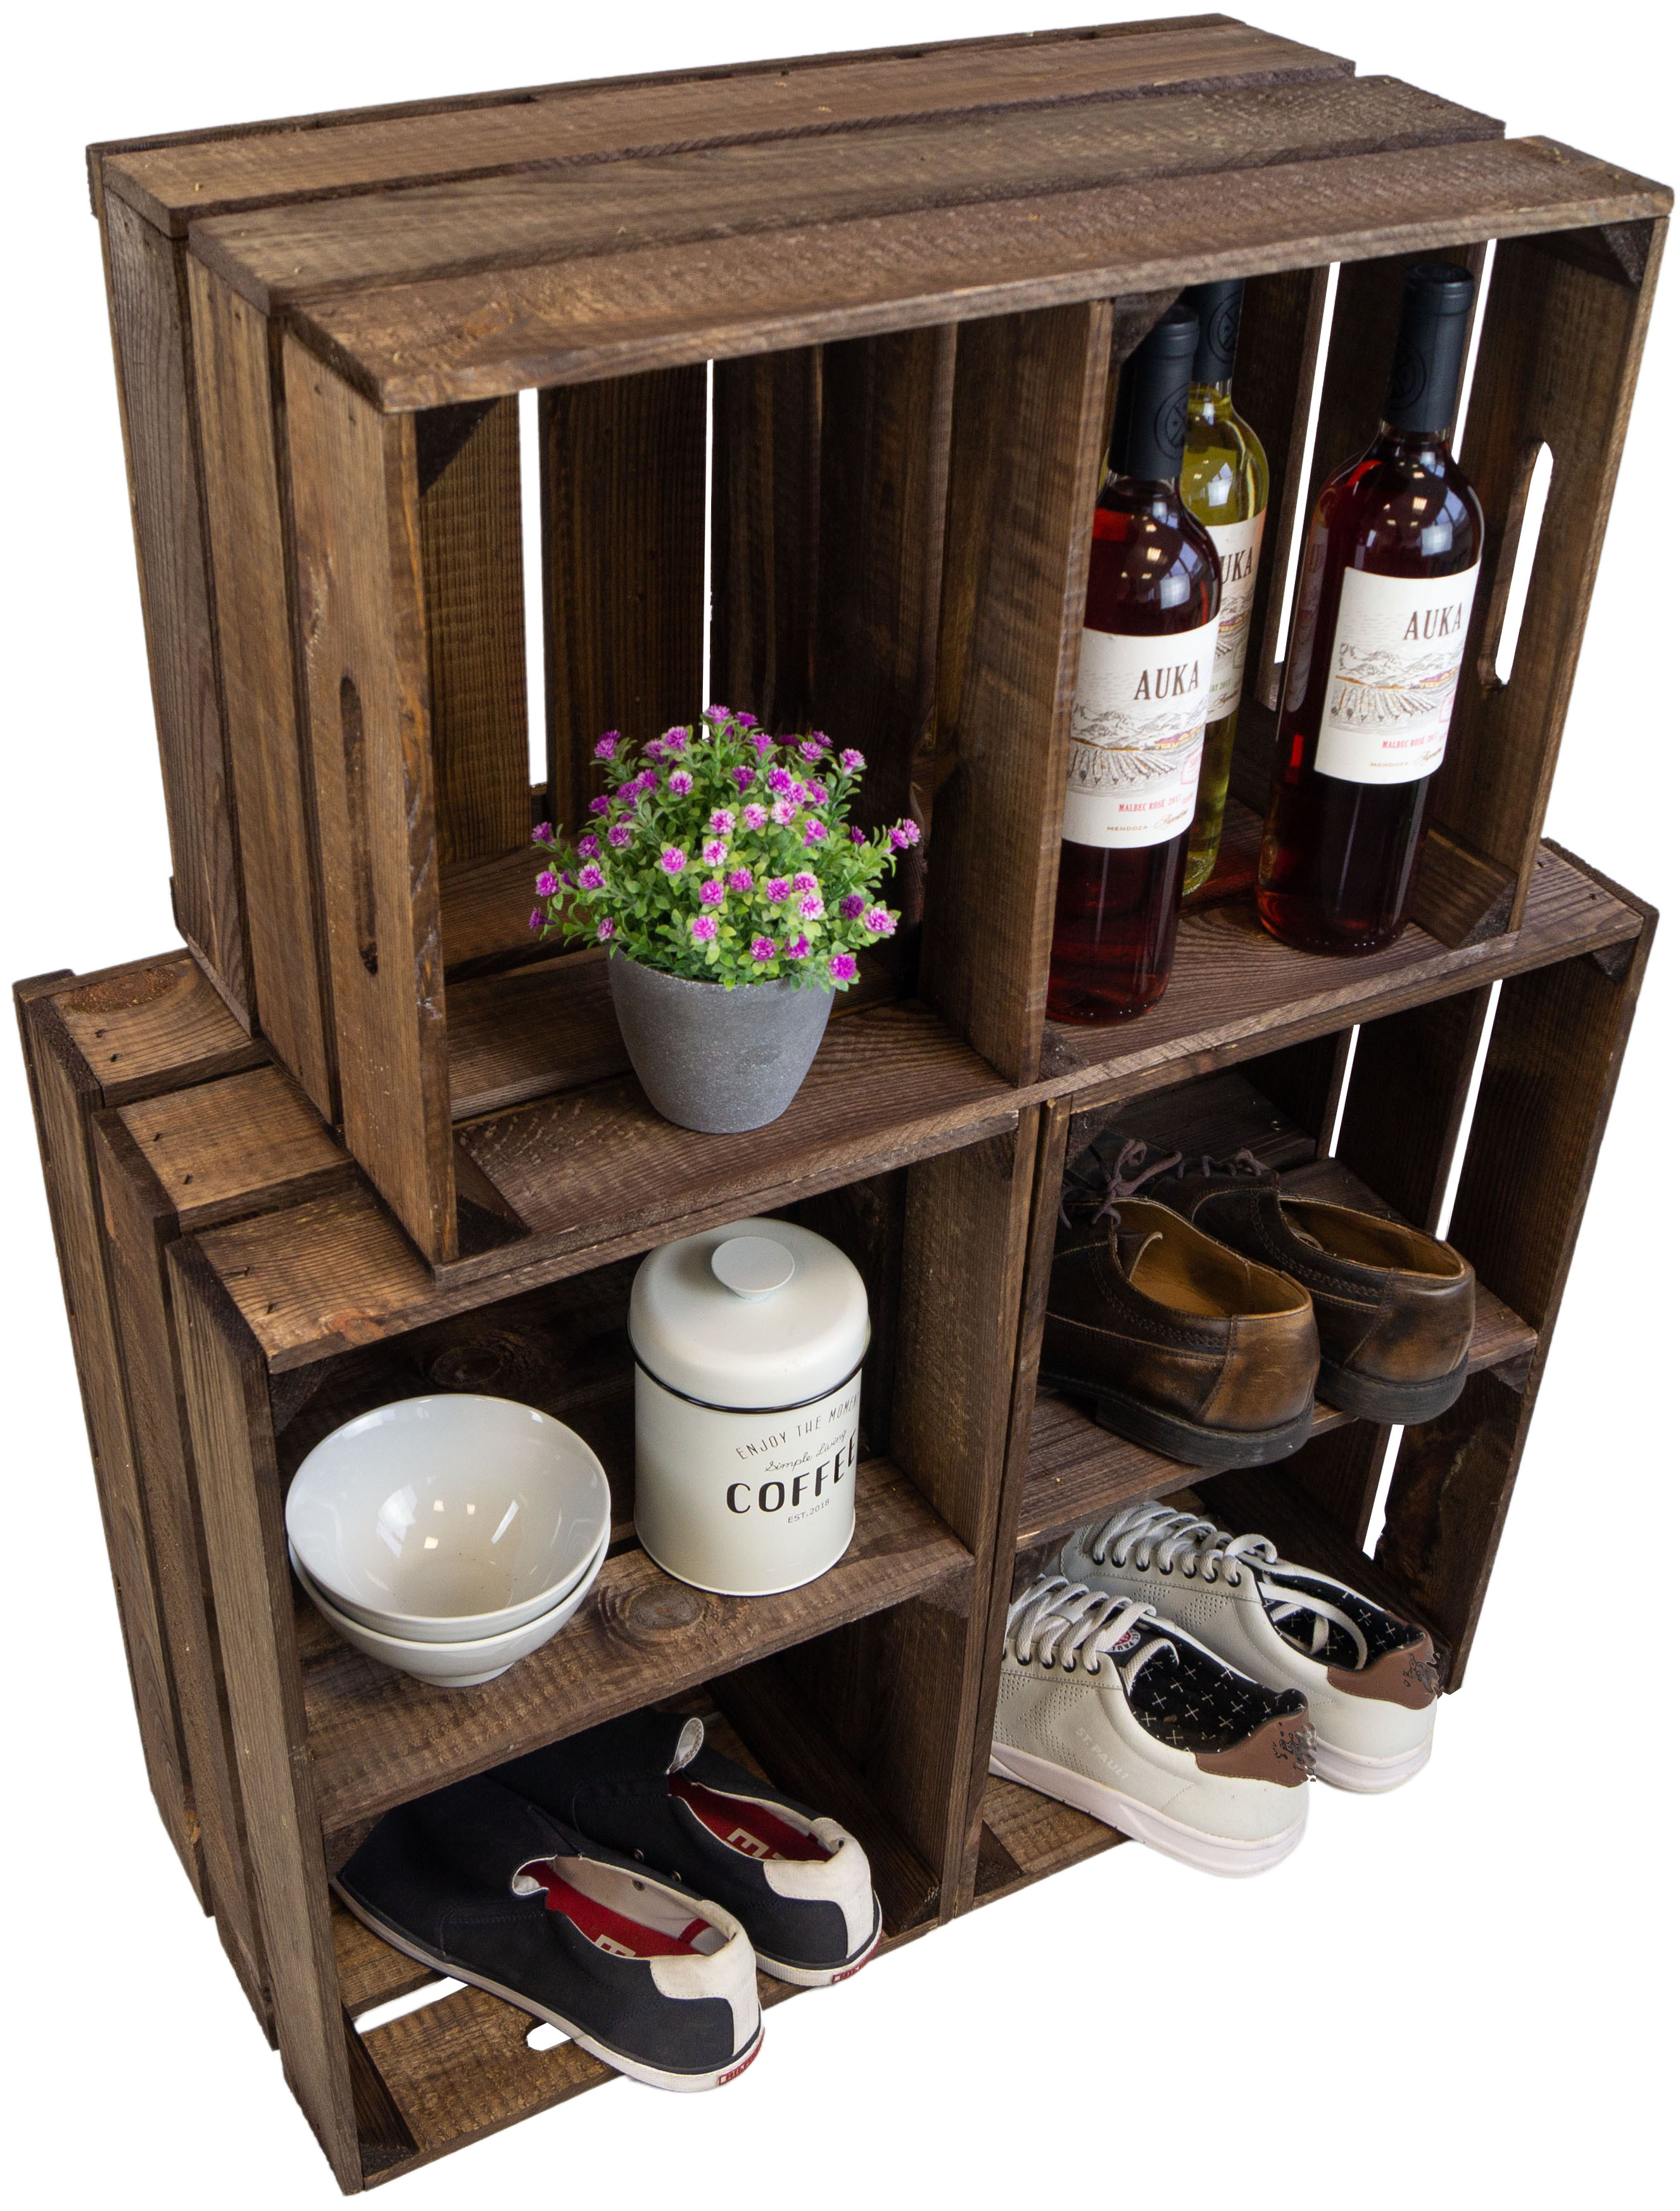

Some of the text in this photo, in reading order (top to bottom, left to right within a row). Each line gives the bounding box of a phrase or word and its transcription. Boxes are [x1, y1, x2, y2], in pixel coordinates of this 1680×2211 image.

[1220, 546, 1253, 584] UKA
[1403, 602, 1462, 640] AUKA
[1133, 660, 1198, 700] AUKA
[1382, 739, 1409, 749] MALBEC
[1118, 802, 1147, 812] MALBEC
[736, 1431, 786, 1460] ENJOY
[797, 1416, 821, 1437] THE
[764, 1429, 847, 1472] Simple Living
[726, 1428, 856, 1514] COFFEE
[788, 1498, 830, 1524] EST.2018
[1111, 1641, 1135, 1650] PAUL
[1091, 1744, 1129, 1779] PAULI
